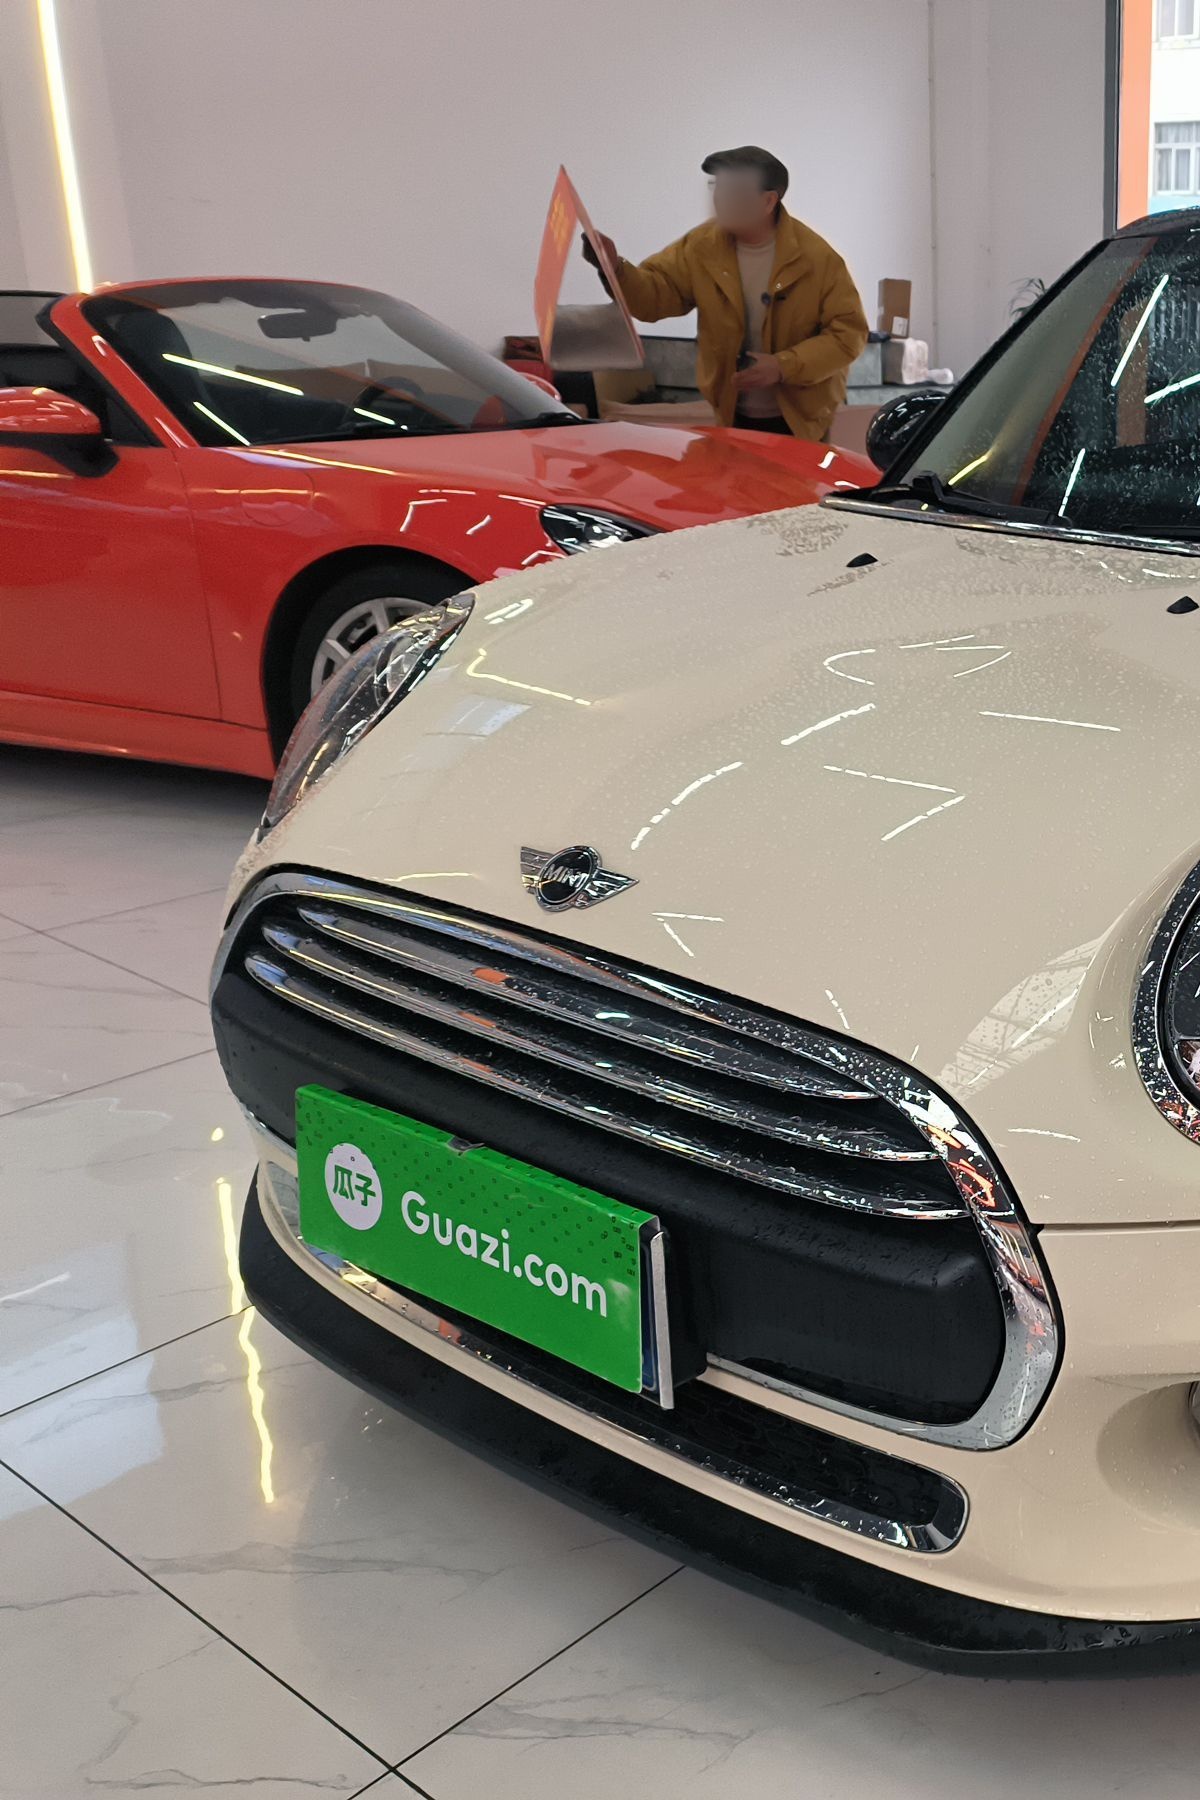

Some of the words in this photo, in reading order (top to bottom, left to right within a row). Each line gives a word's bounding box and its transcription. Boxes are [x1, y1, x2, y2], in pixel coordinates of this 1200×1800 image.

[543, 863, 590, 888] MINI
[332, 1164, 377, 1207] 瓜子
[401, 1190, 607, 1318] Guazi.com
